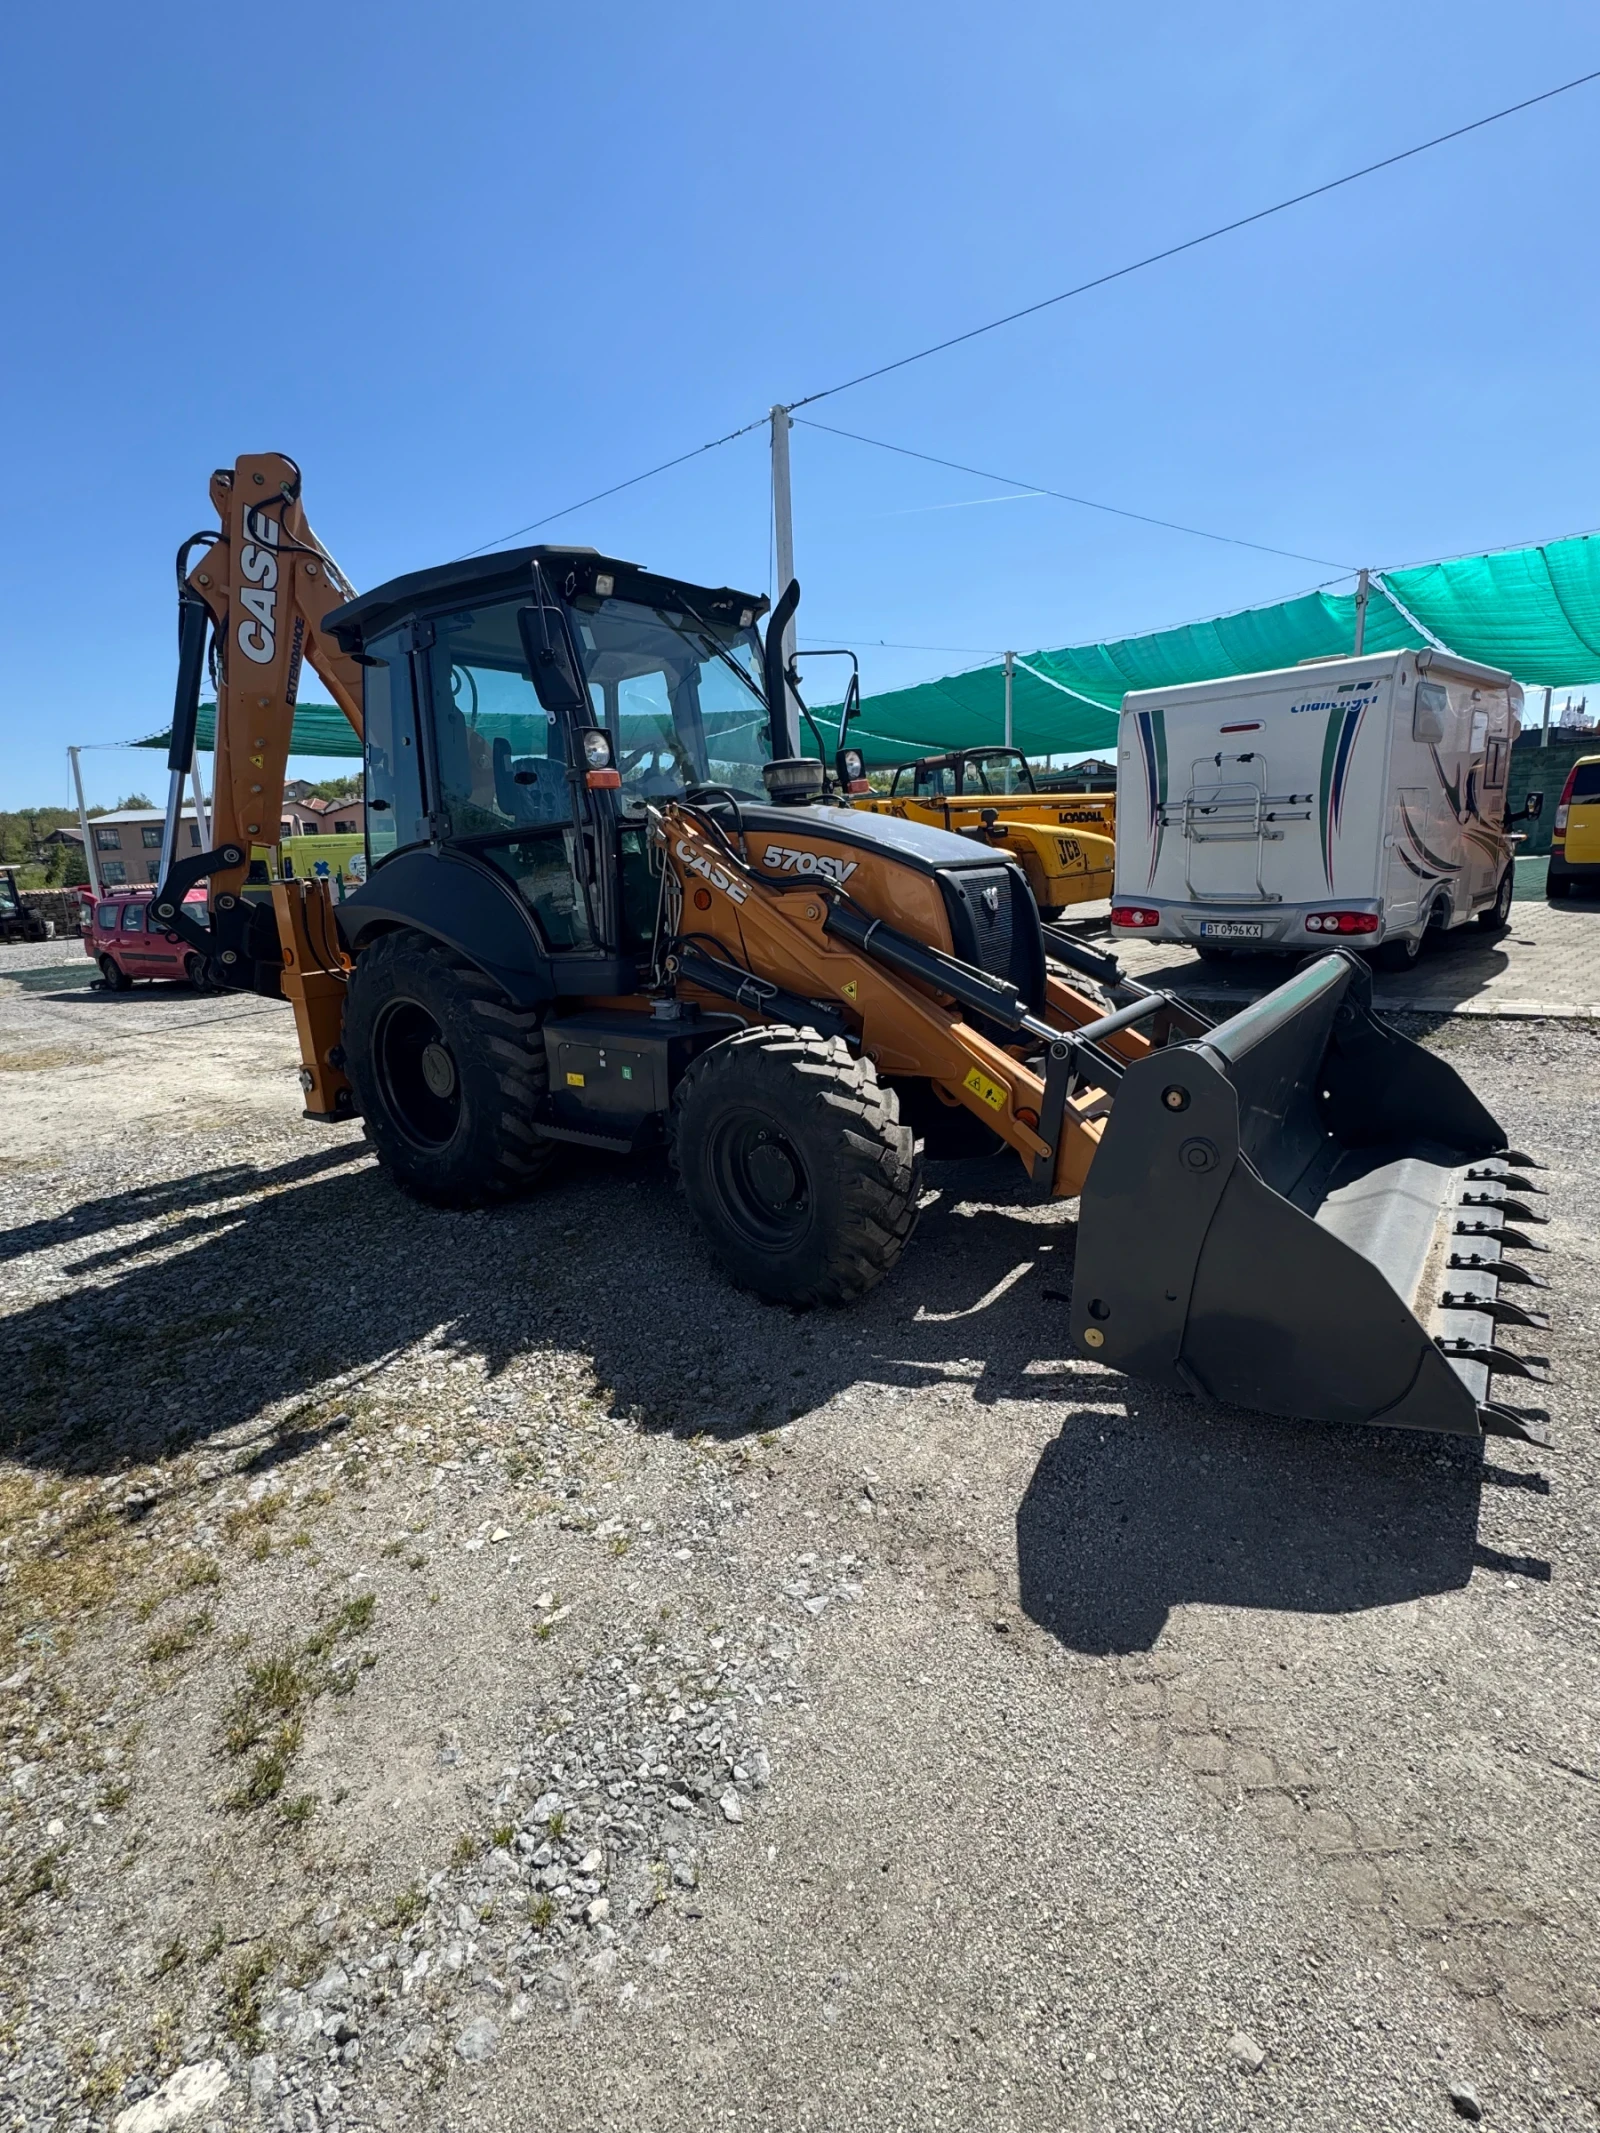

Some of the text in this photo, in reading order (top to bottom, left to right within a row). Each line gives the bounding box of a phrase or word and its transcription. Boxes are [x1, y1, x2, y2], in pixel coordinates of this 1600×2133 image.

[238, 503, 280, 664] CASE
[286, 616, 305, 706] EXTENDAHOE
[1059, 811, 1104, 824] LOADALL
[676, 839, 753, 905] CASE
[763, 844, 861, 883] 570SV
[1057, 839, 1081, 866] JCB
